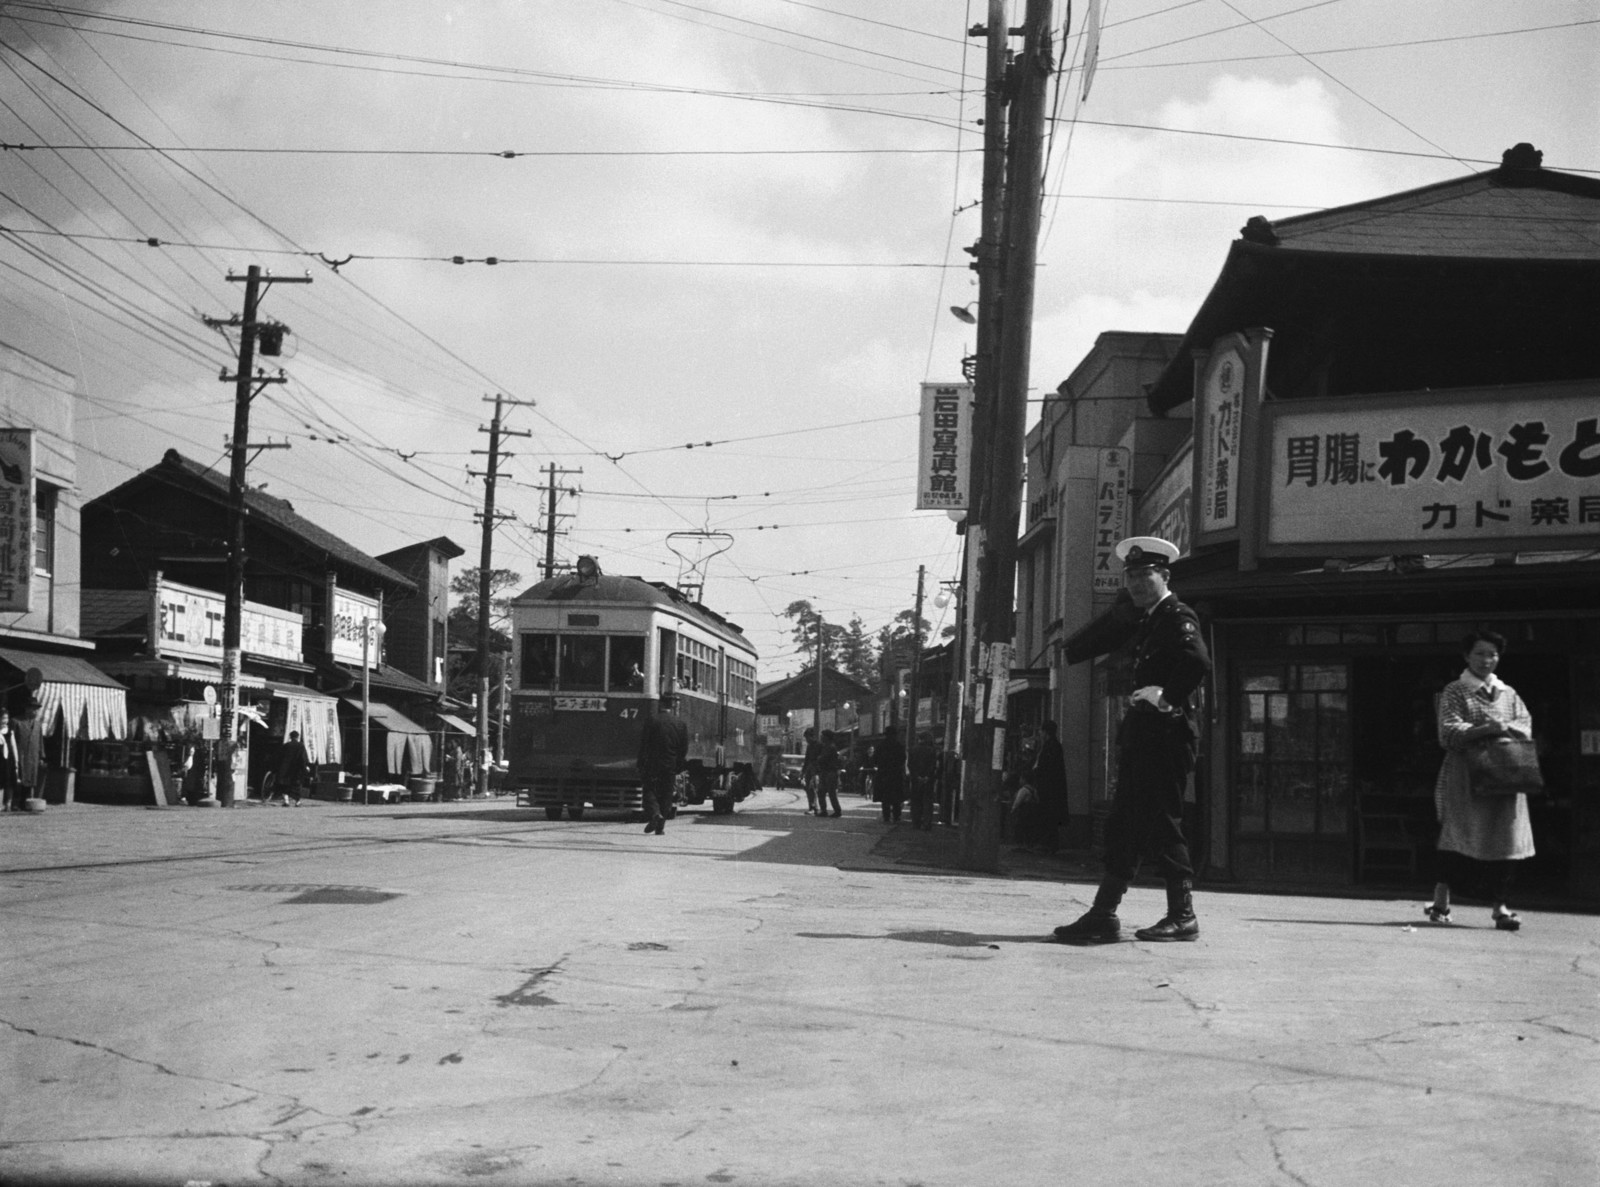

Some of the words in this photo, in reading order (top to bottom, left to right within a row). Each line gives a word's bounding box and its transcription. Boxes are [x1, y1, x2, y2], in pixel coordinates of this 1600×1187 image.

[1097, 481, 1115, 570] パラエス
[1422, 495, 1600, 530] カド薬局
[620, 709, 639, 719] 47
